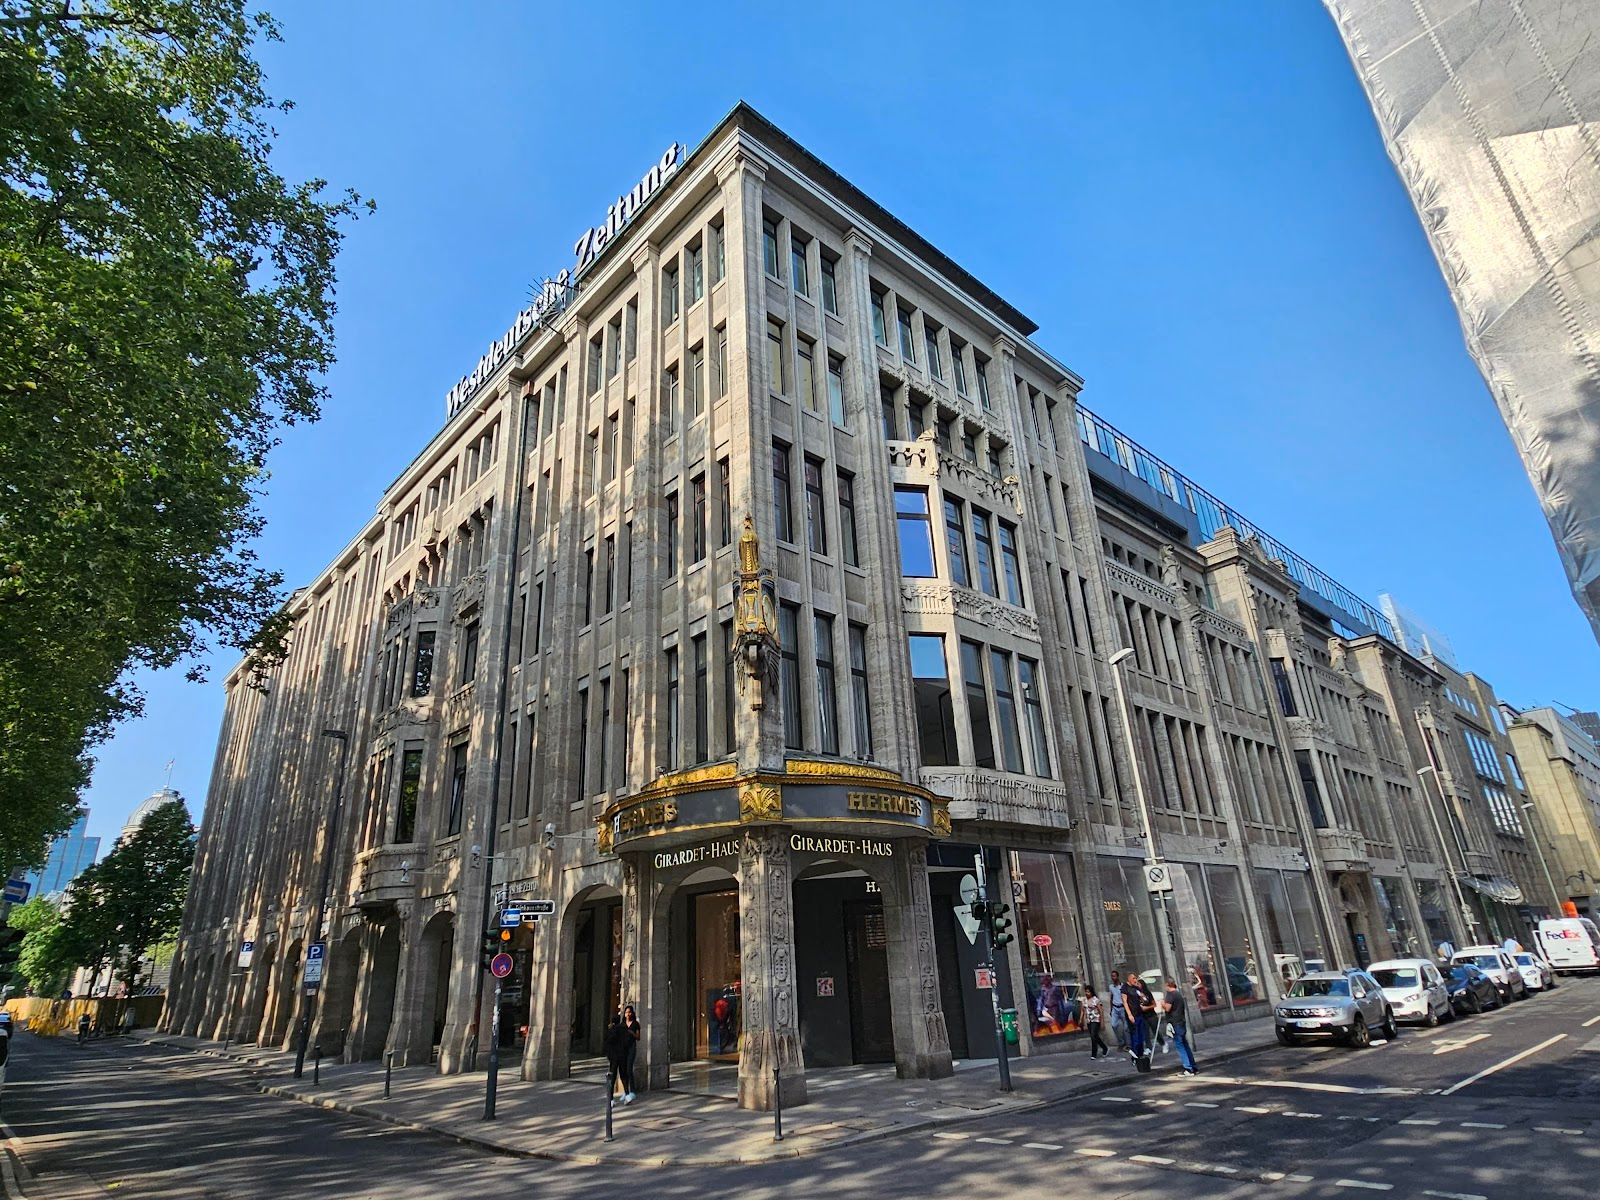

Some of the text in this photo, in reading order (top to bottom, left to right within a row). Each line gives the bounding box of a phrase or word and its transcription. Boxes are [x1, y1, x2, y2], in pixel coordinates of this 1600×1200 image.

[446, 141, 679, 419] Westdeutsche Zeitung
[655, 840, 740, 868] GIRARDET-HAUS
[790, 834, 893, 857] GIRARDET-HAUS
[1545, 930, 1581, 940] FedEx
[243, 942, 251, 952] P
[310, 946, 320, 958] P
